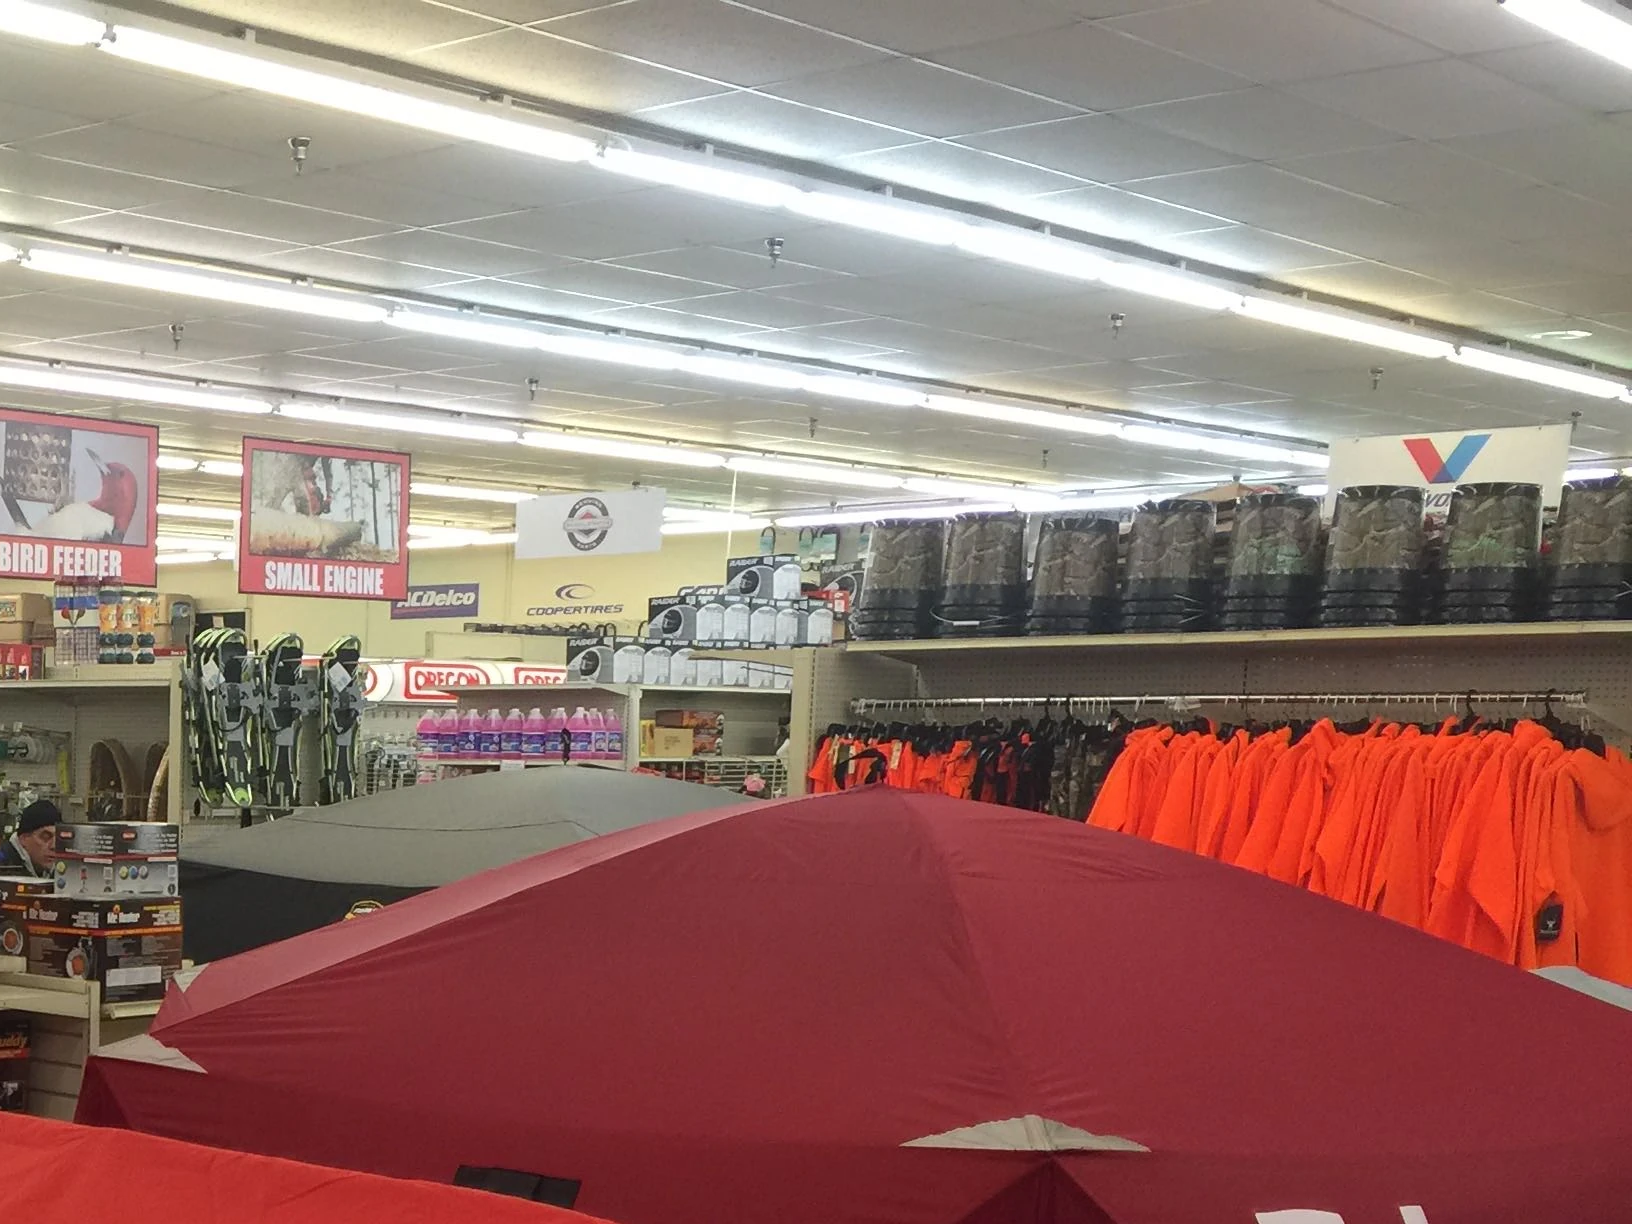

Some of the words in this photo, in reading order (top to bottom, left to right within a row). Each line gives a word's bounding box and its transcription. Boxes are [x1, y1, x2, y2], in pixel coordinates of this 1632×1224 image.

[53, 546, 123, 577] FEEDER
[265, 561, 321, 592] SMALL
[324, 565, 385, 596] ENGINE
[396, 589, 477, 608] ACDelco
